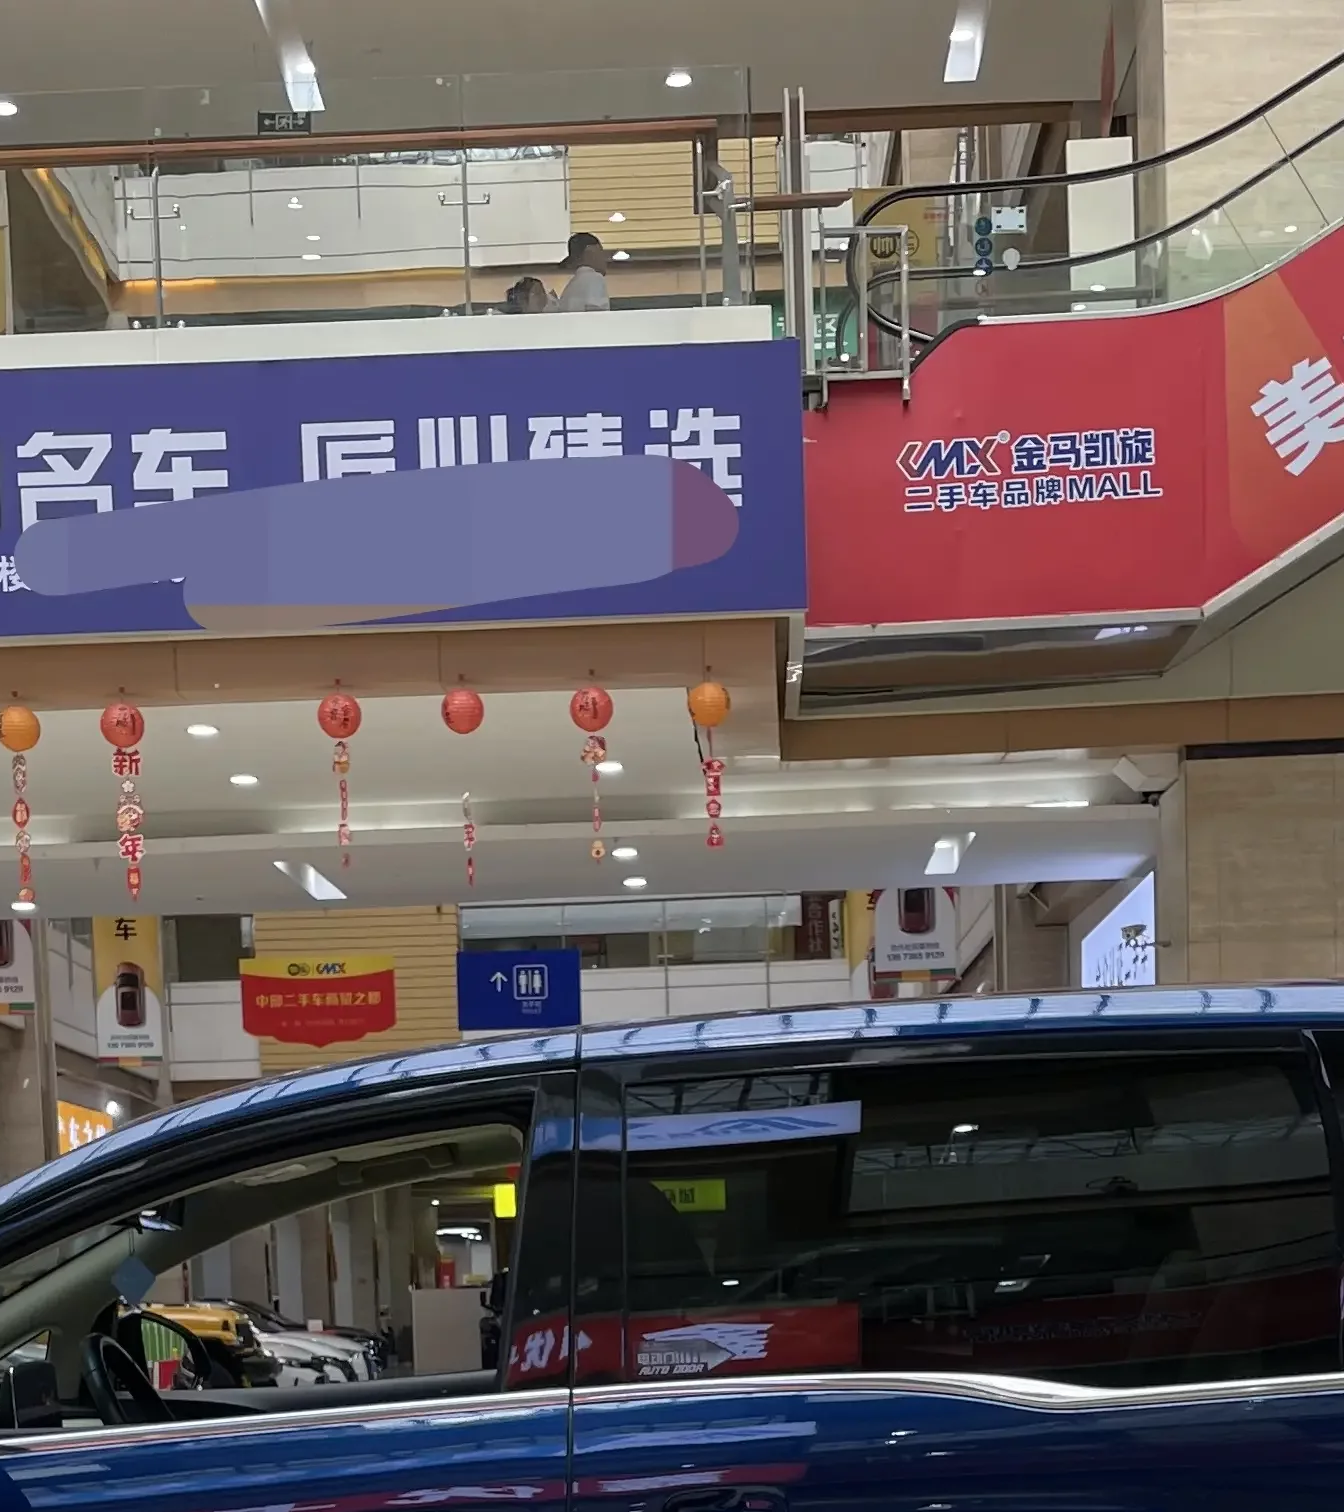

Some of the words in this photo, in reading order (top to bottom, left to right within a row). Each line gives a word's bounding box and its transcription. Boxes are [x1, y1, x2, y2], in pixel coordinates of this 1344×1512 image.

[1011, 427, 1156, 471] 金马凯旋
[903, 470, 1164, 513] 二手车品牌MALL
[114, 917, 138, 941] 车
[637, 1364, 670, 1378] AUTO
[672, 1363, 704, 1376] DOOR
